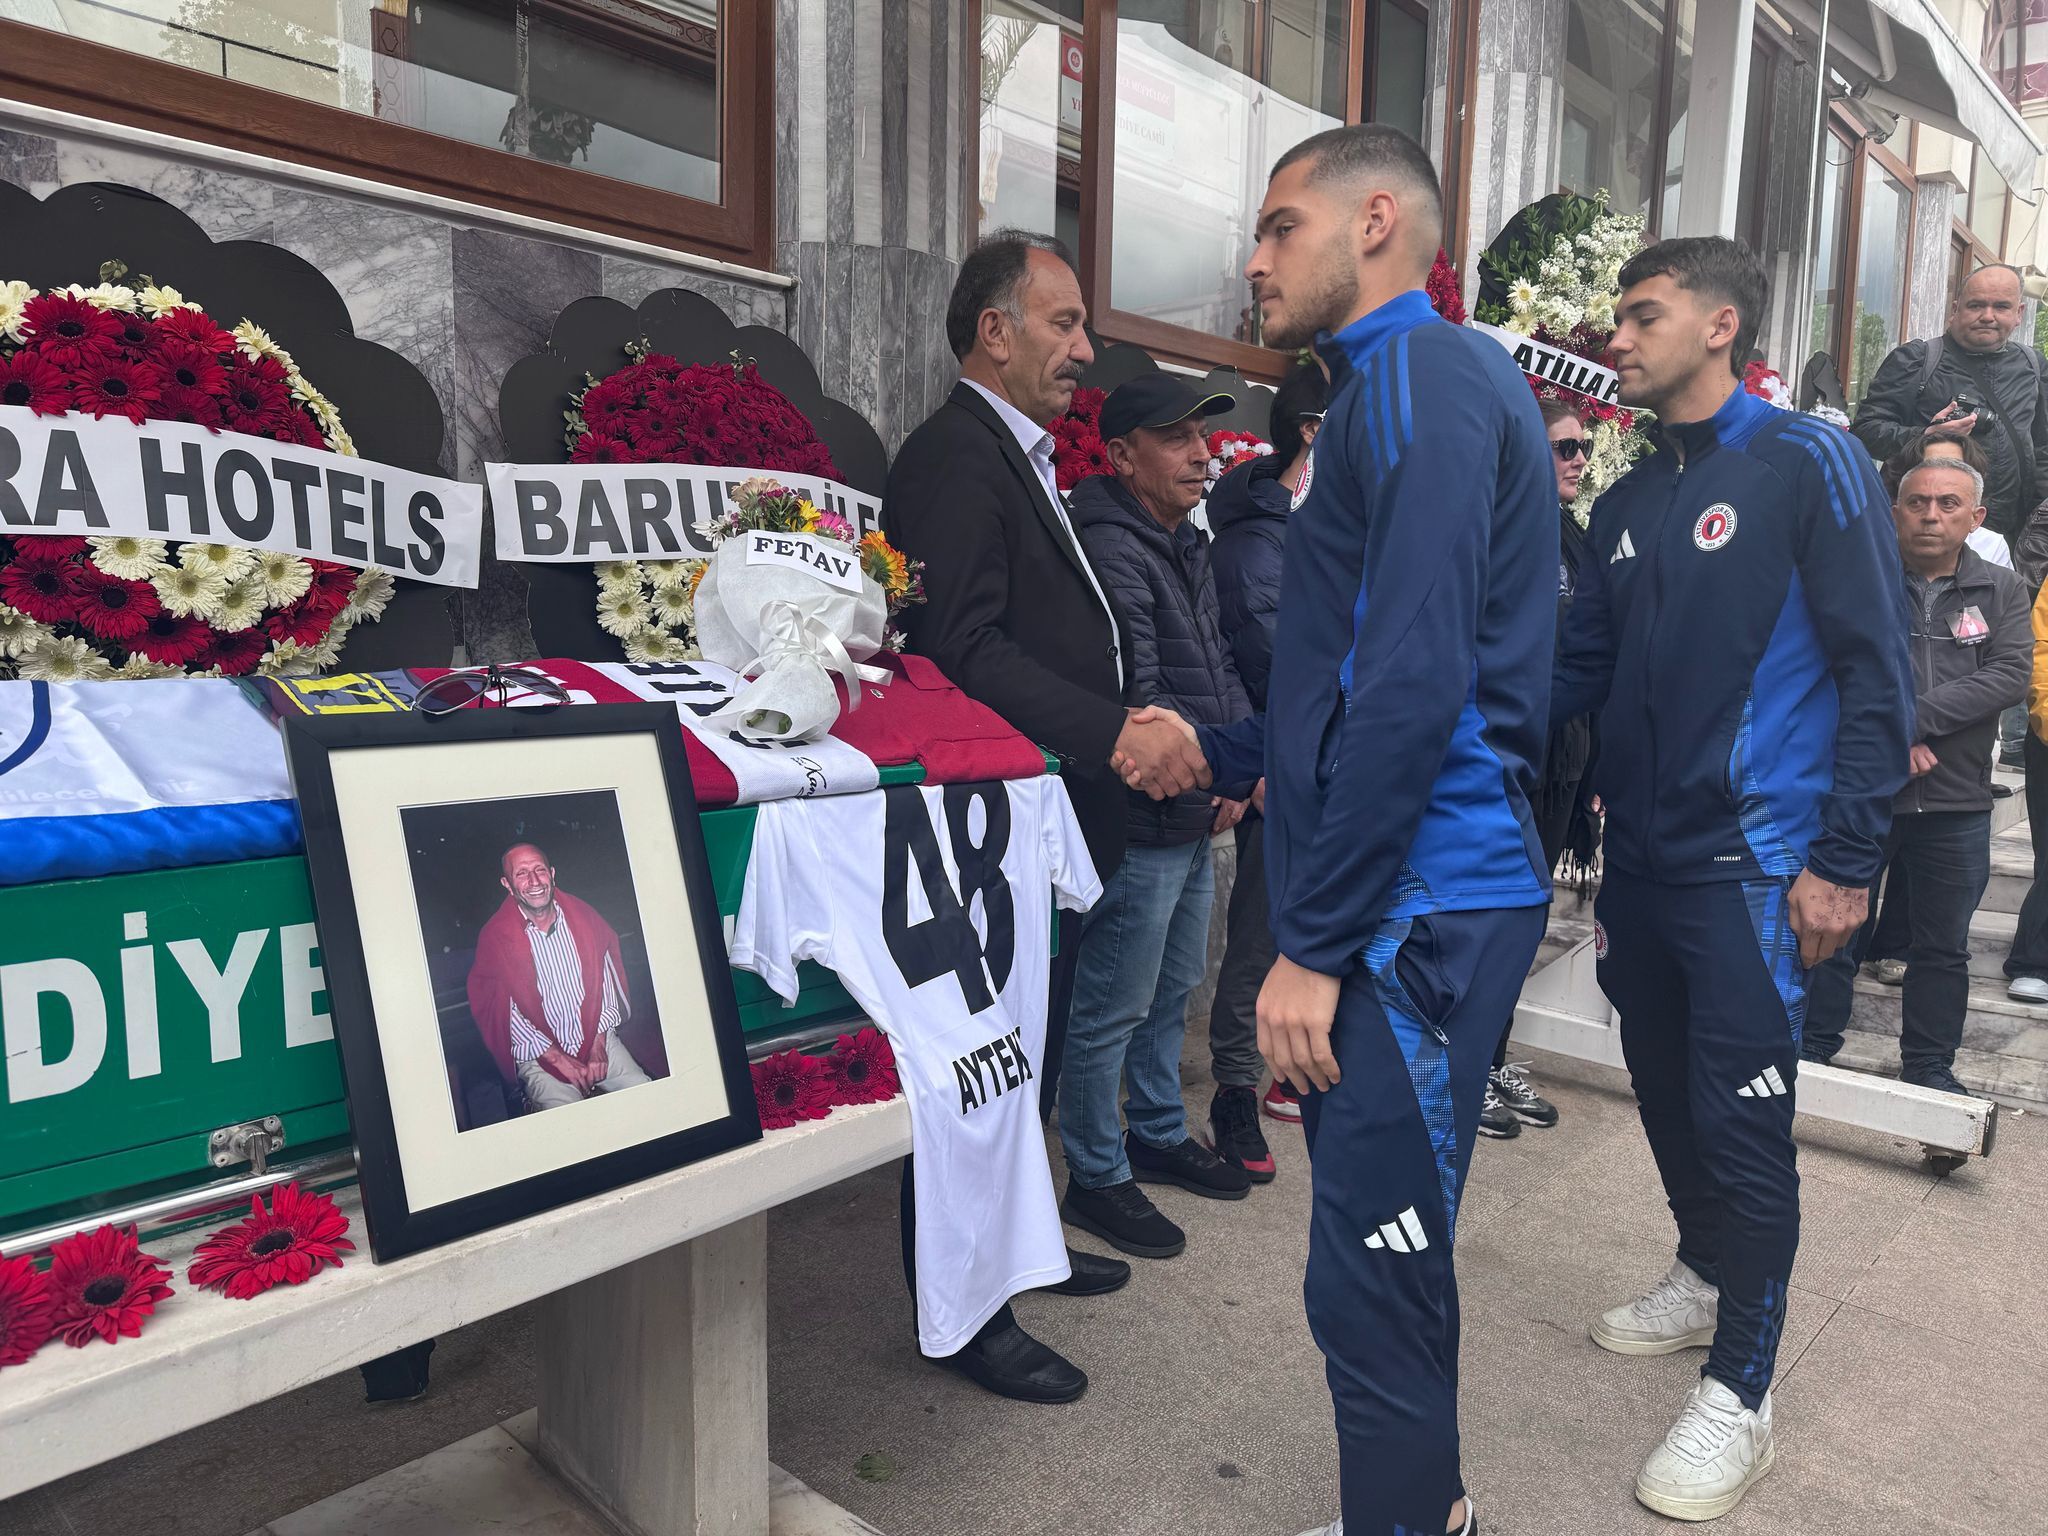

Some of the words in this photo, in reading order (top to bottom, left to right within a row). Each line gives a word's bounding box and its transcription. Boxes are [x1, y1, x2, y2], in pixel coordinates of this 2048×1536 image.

[1512, 343, 1606, 398] ATİLLA
[139, 436, 445, 576] HOTELS
[753, 536, 852, 578] FETAV
[881, 780, 1015, 1016] 48
